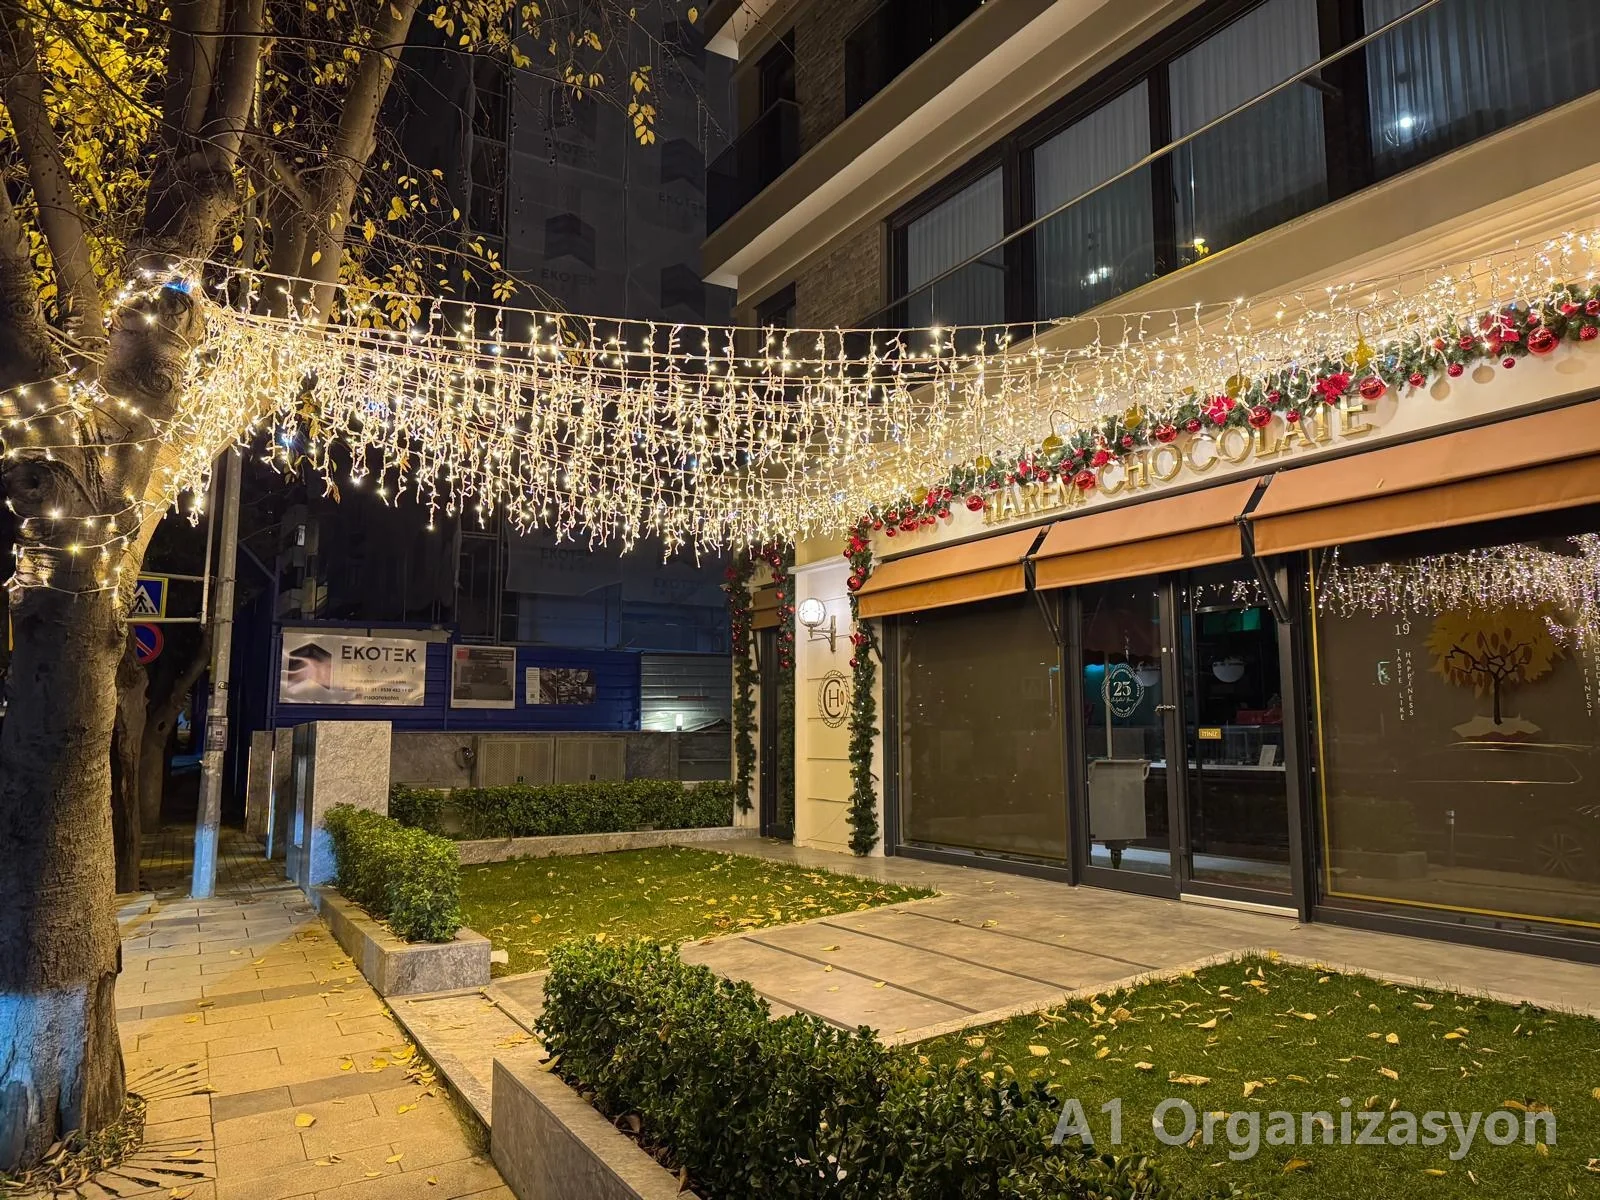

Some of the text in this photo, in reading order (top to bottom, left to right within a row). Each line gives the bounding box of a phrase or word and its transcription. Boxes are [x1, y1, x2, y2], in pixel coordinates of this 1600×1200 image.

[1099, 394, 1373, 498] CHOCOLATE
[341, 645, 417, 662] EKOTEK
[1113, 681, 1132, 697] 25
[1405, 651, 1414, 716] HAPPINESS
[1584, 668, 1593, 717] FINEST
